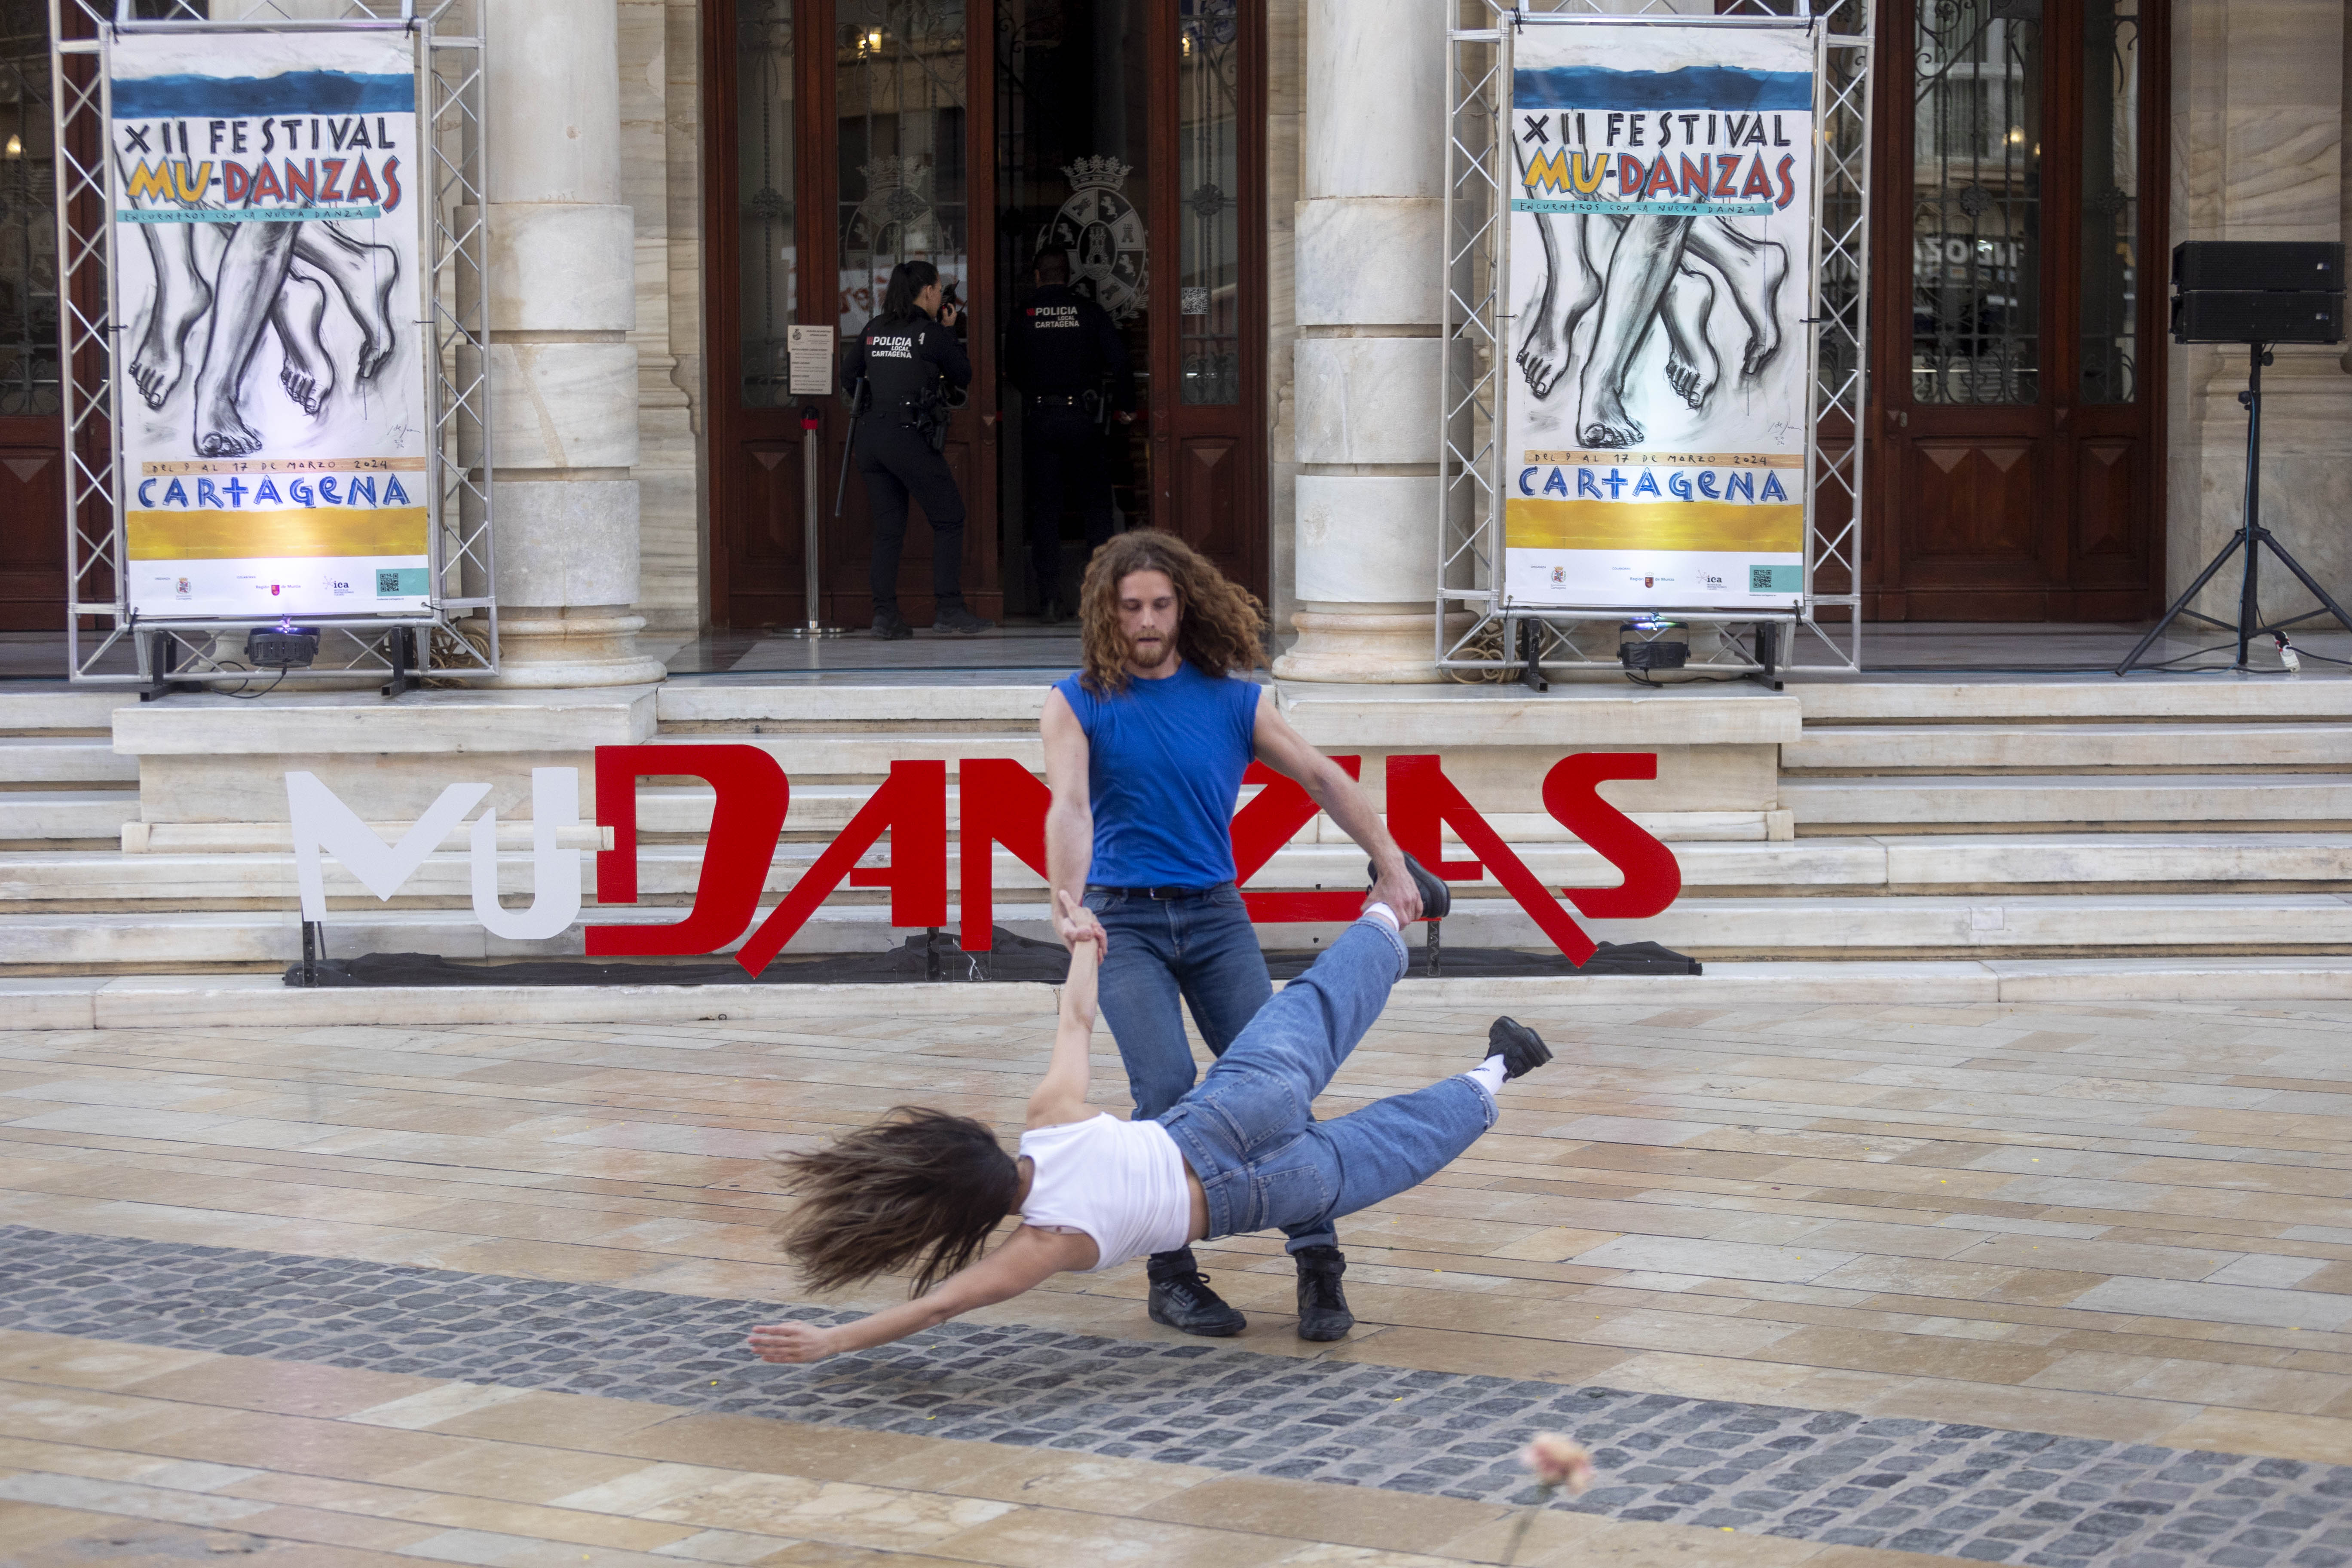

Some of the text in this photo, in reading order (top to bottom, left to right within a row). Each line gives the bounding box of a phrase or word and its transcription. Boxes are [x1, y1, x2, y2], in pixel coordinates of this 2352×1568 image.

[125, 117, 395, 154] XII FESTIVAL
[1522, 112, 1792, 148] XII FESTIVAL
[127, 153, 401, 213] MU-DANZAS
[1522, 146, 1796, 211] MU-DANZAS
[315, 210, 363, 218] DANZA
[1035, 306, 1078, 316] POLICIA
[873, 336, 912, 347] POLICIA
[872, 350, 912, 358] CARTAGENA
[1566, 452, 1571, 460] 9
[1614, 454, 1629, 463] 17
[1733, 455, 1767, 466] 2024
[232, 463, 248, 472] 17
[354, 460, 387, 468] 2024
